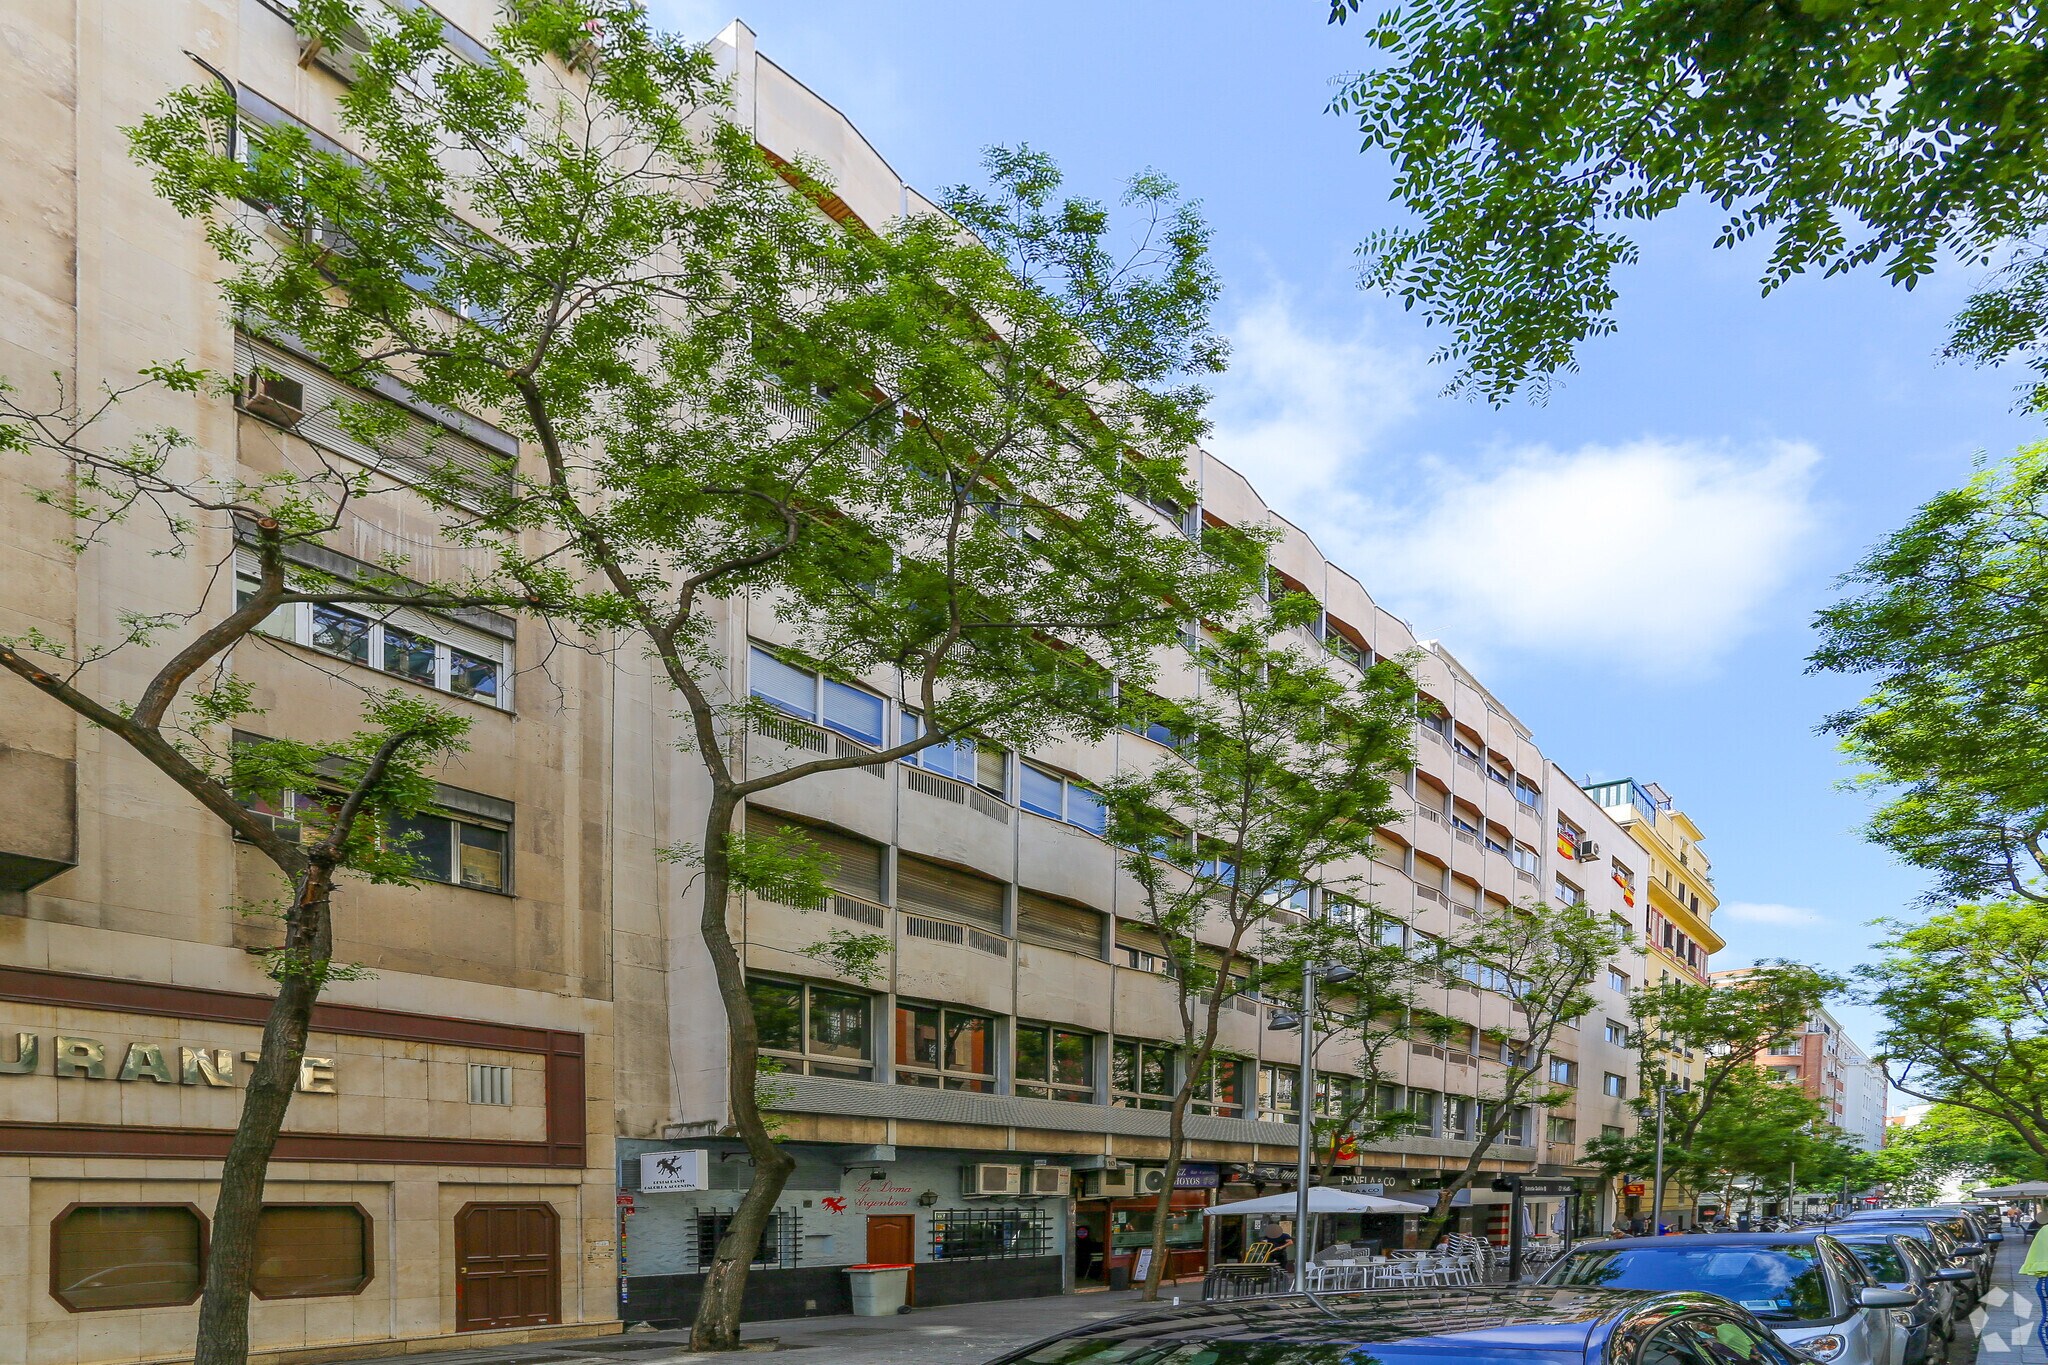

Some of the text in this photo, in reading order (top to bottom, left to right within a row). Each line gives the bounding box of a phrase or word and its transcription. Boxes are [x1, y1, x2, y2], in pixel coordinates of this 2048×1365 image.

[0, 1032, 337, 1093] URANE
[854, 1180, 912, 1193] La Doma
[1383, 1177, 1396, 1187] CO
[855, 1194, 908, 1211] Argentina
